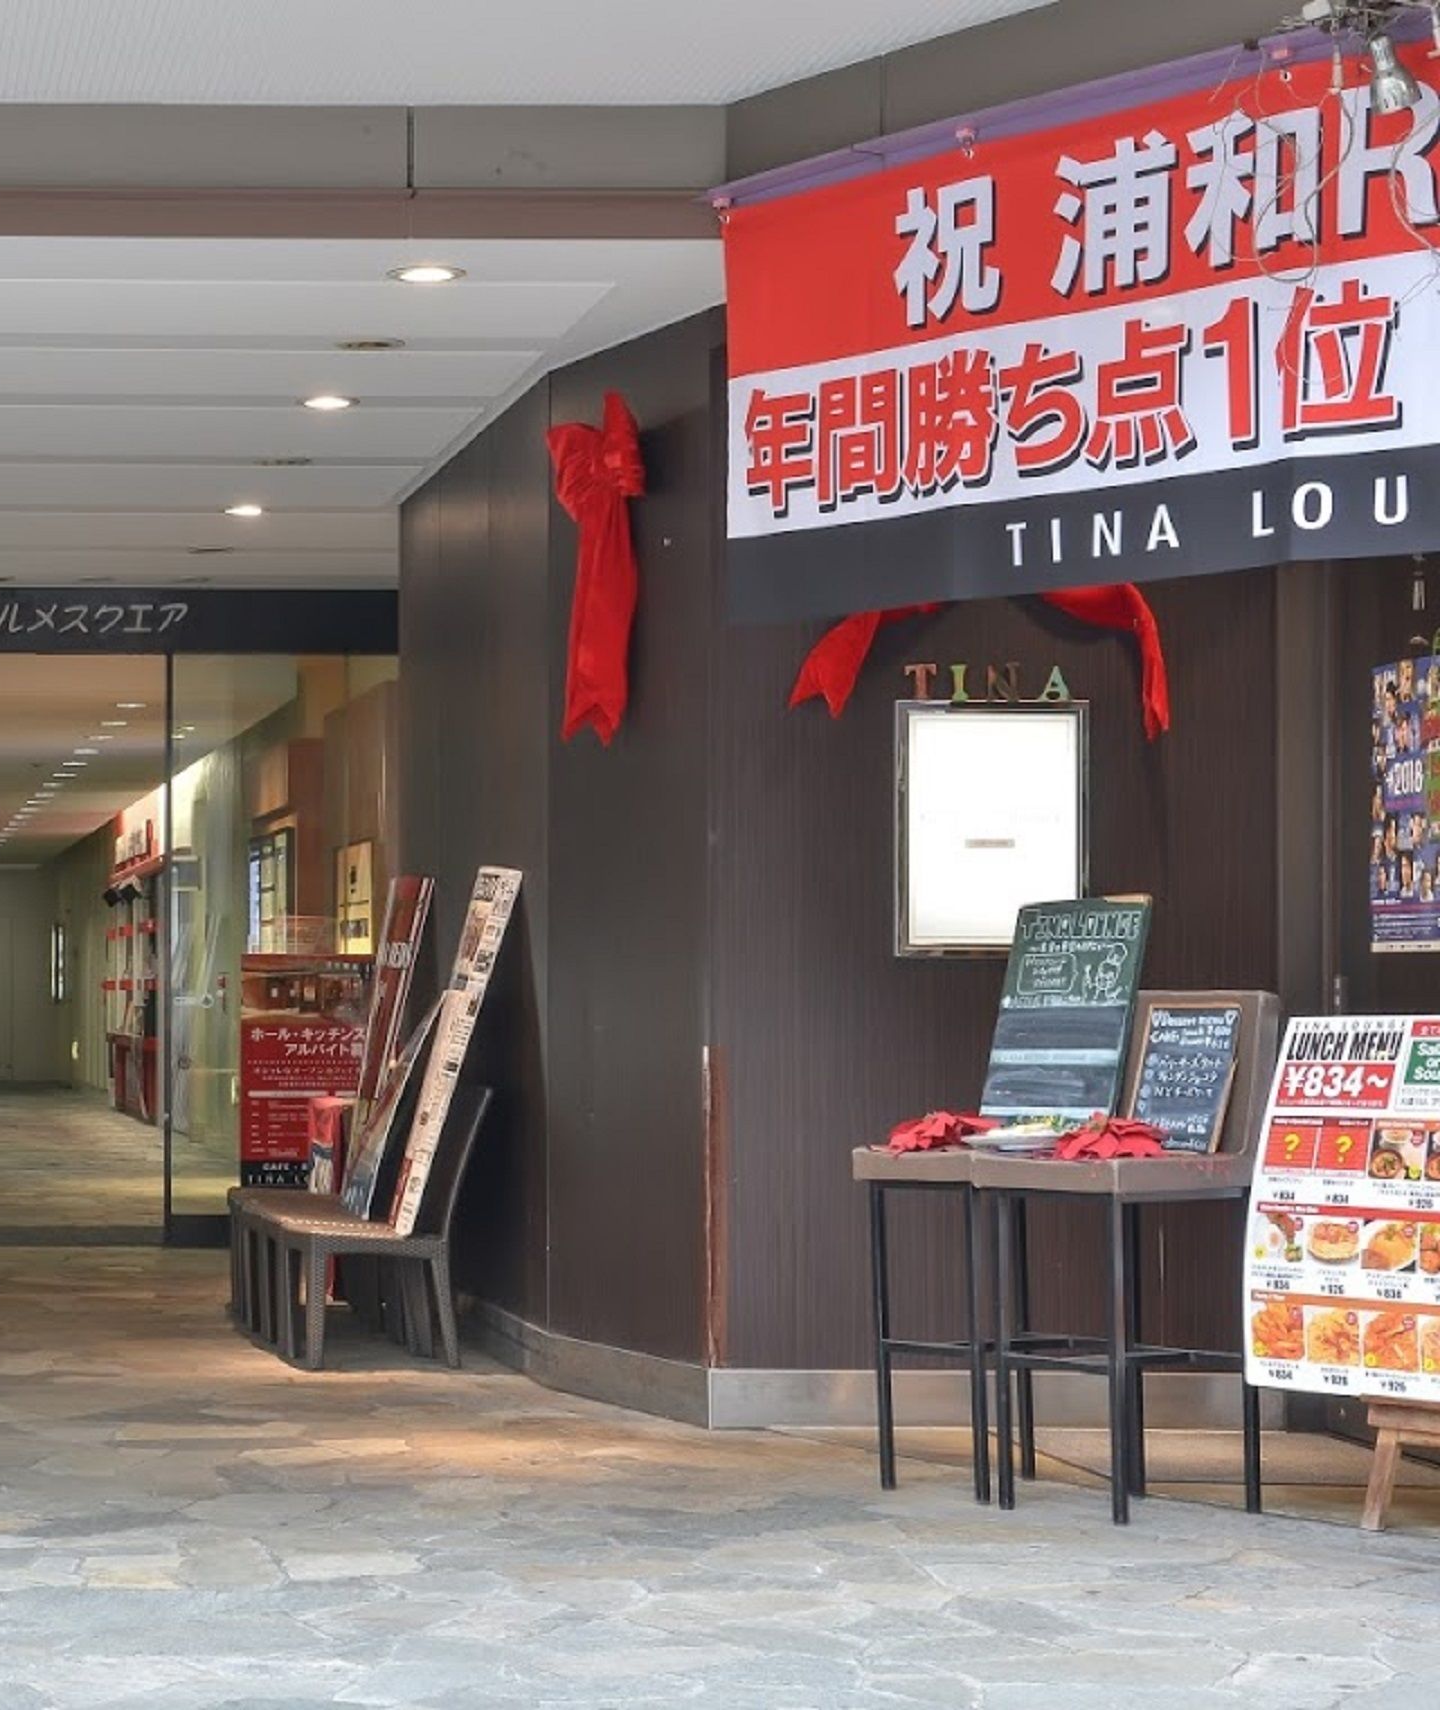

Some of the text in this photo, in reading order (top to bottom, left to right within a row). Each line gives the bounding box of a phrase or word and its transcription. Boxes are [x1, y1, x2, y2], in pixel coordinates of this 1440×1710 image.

[893, 175, 1000, 329] 祝
[743, 279, 1403, 518] 年間勝ち点1位
[1006, 475, 1409, 566] TINA LOU
[904, 662, 1073, 700] TINA
[1286, 1031, 1404, 1061] LUNCH MENU
